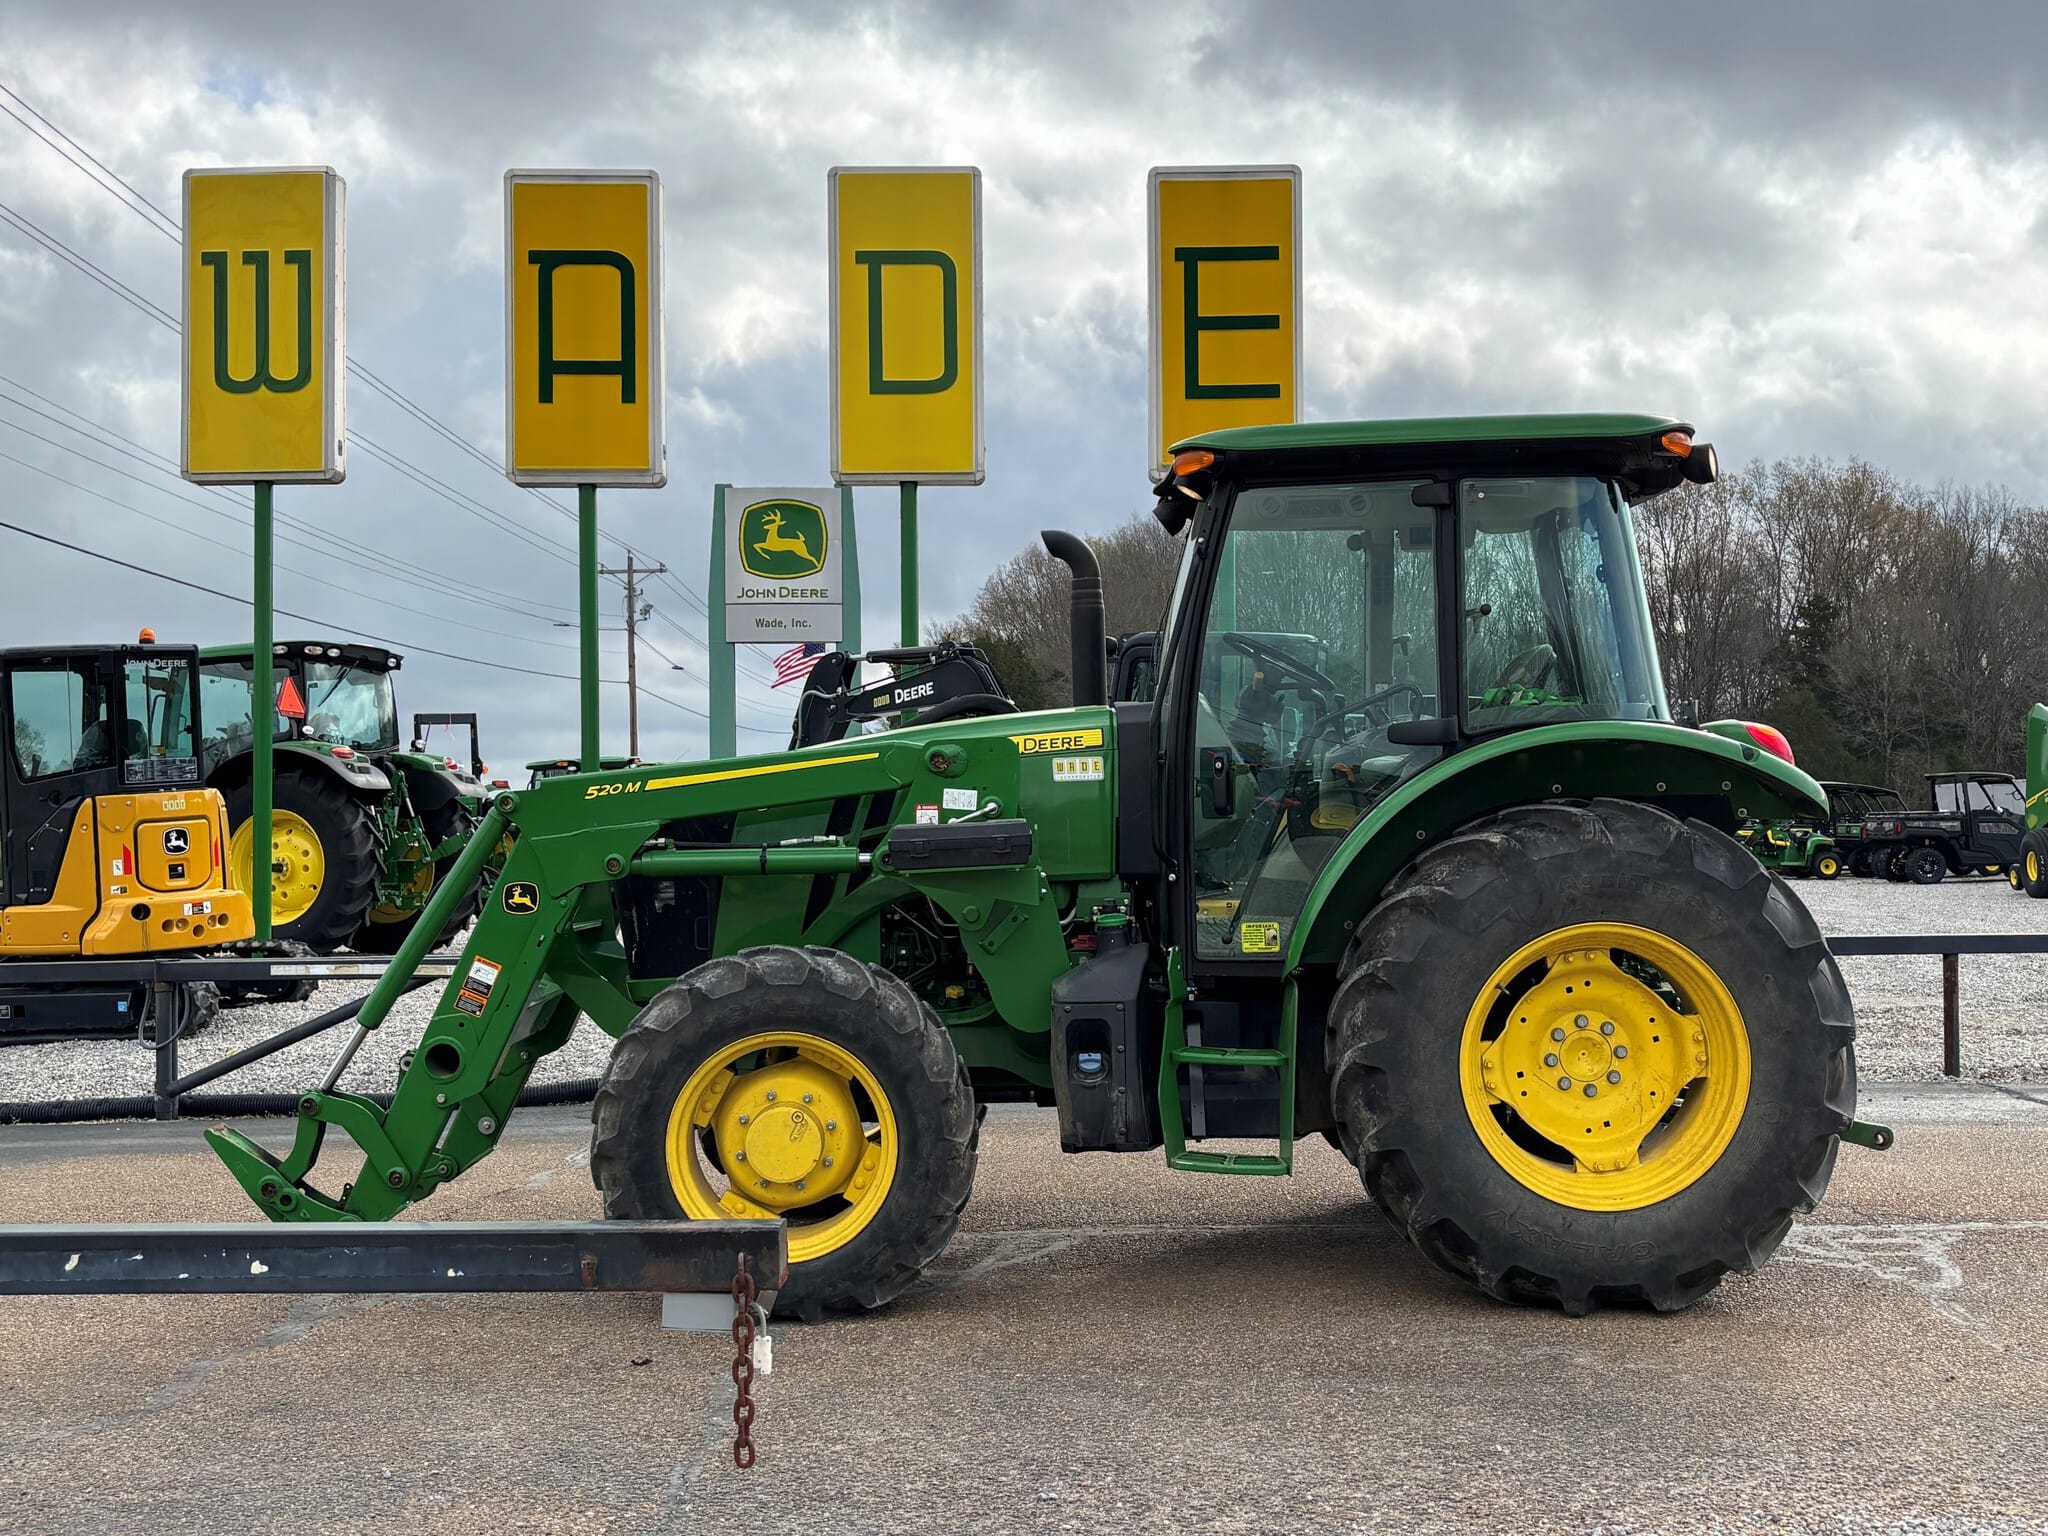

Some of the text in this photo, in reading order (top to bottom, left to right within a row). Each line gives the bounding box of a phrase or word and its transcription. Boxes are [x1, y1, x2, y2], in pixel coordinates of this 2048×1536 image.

[737, 587, 829, 599] JOHN DEERE
[755, 618, 812, 629] Wade, Inc.
[153, 659, 188, 667] DEERE
[894, 682, 934, 704] DEERE
[1023, 736, 1084, 752] DEERE
[584, 784, 623, 800] 520
